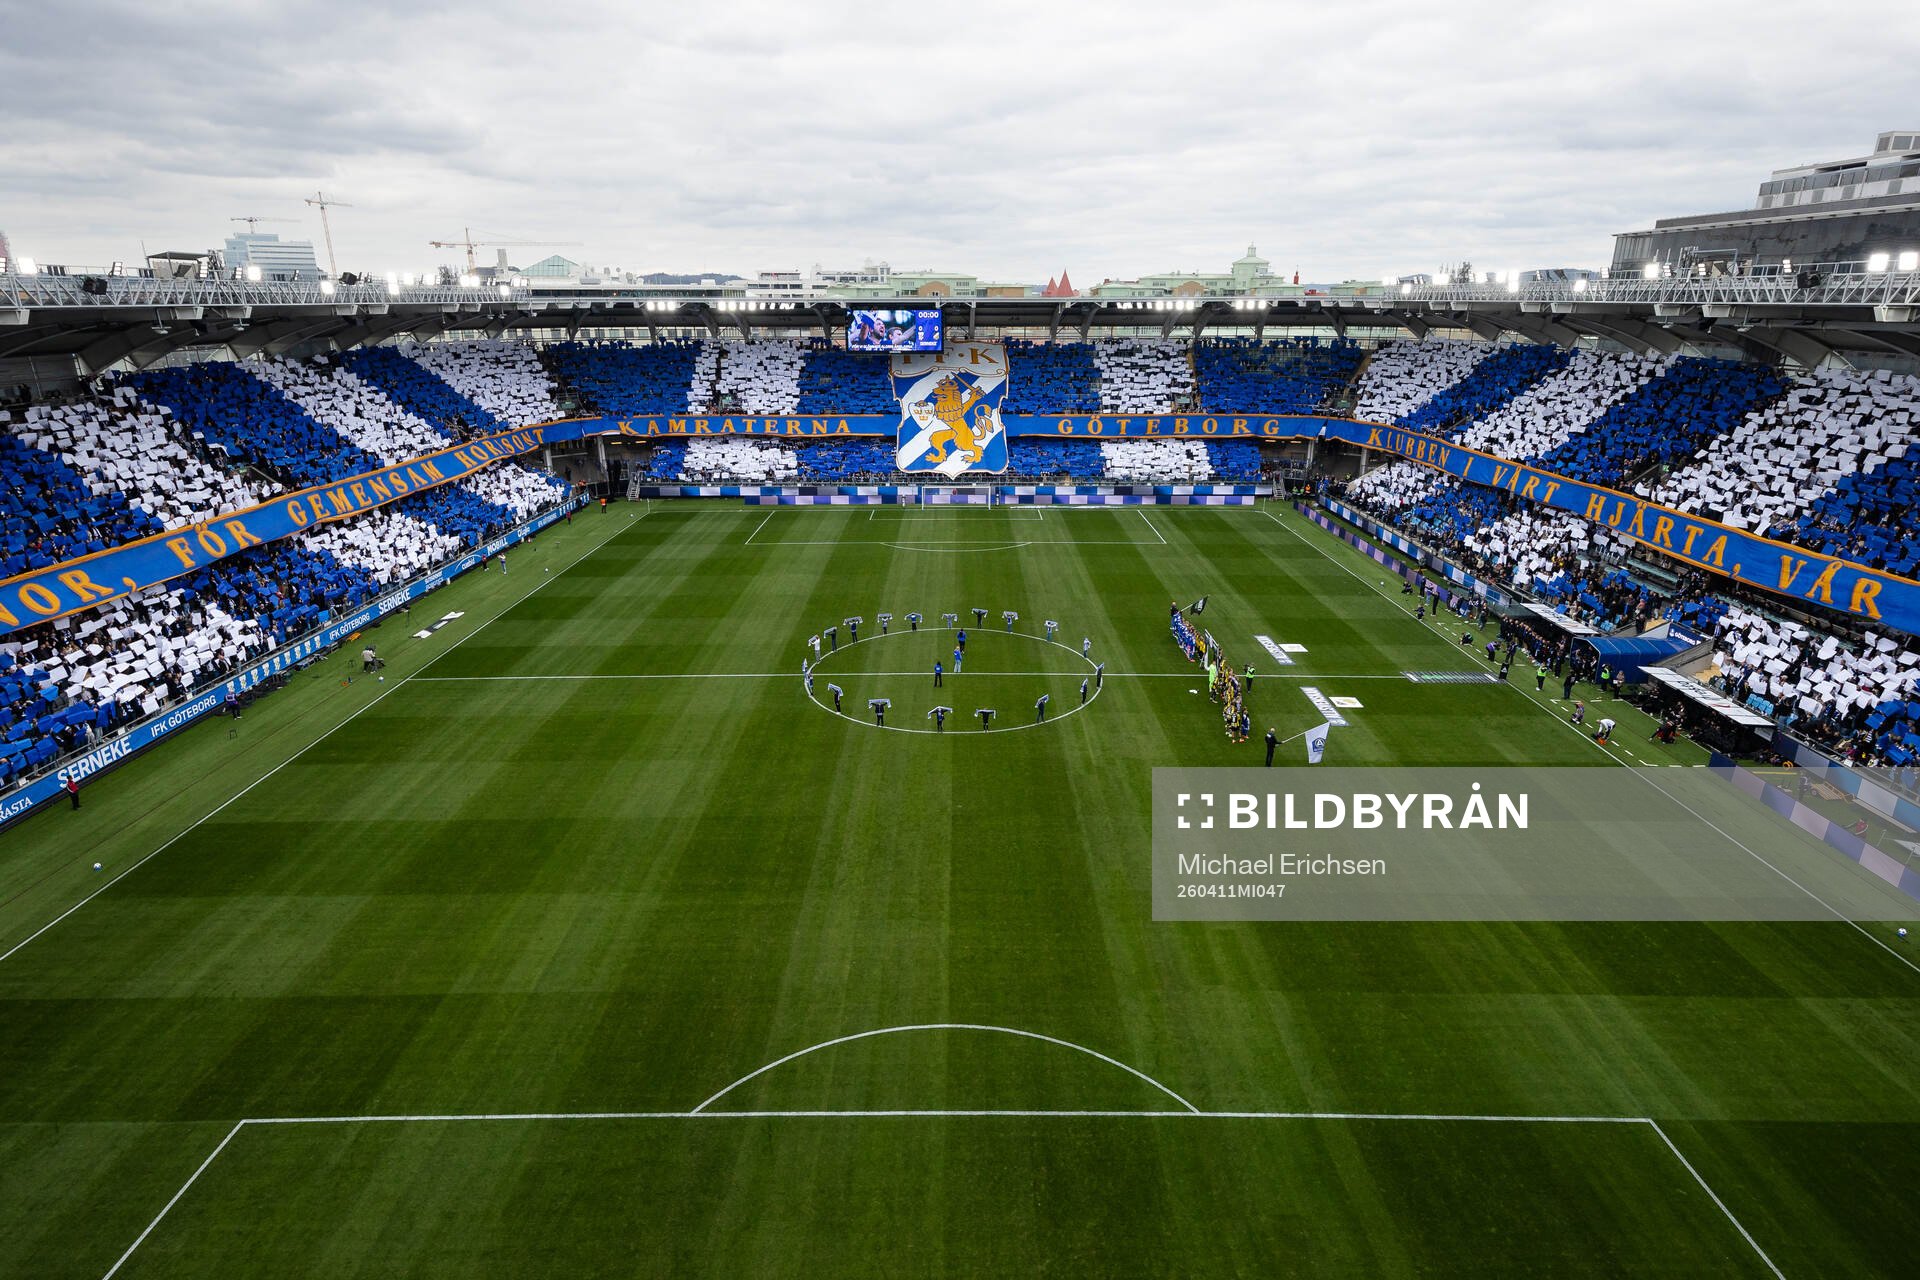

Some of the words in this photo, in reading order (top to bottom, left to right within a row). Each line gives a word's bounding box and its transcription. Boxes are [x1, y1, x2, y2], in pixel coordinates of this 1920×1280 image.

[617, 418, 851, 435] KAMRATERNA
[1058, 415, 1279, 435] GÖTEBORG
[166, 520, 262, 568] FÖR
[287, 460, 445, 527] GEMENSAM
[454, 428, 545, 469] HORISONT
[1366, 428, 1450, 468] KLUBBEN
[1463, 456, 1475, 477] I
[1491, 465, 1561, 503] VÅRT
[1584, 493, 1742, 578] HJÄRTA,
[1777, 555, 1883, 619] VÅR
[378, 588, 411, 615] SERNEKE
[329, 628, 340, 641] IFK
[340, 612, 370, 635] GÖTEBORG
[150, 720, 168, 738] IFK
[168, 695, 217, 727] GÖTEBORG
[57, 737, 133, 789] SERNEKE
